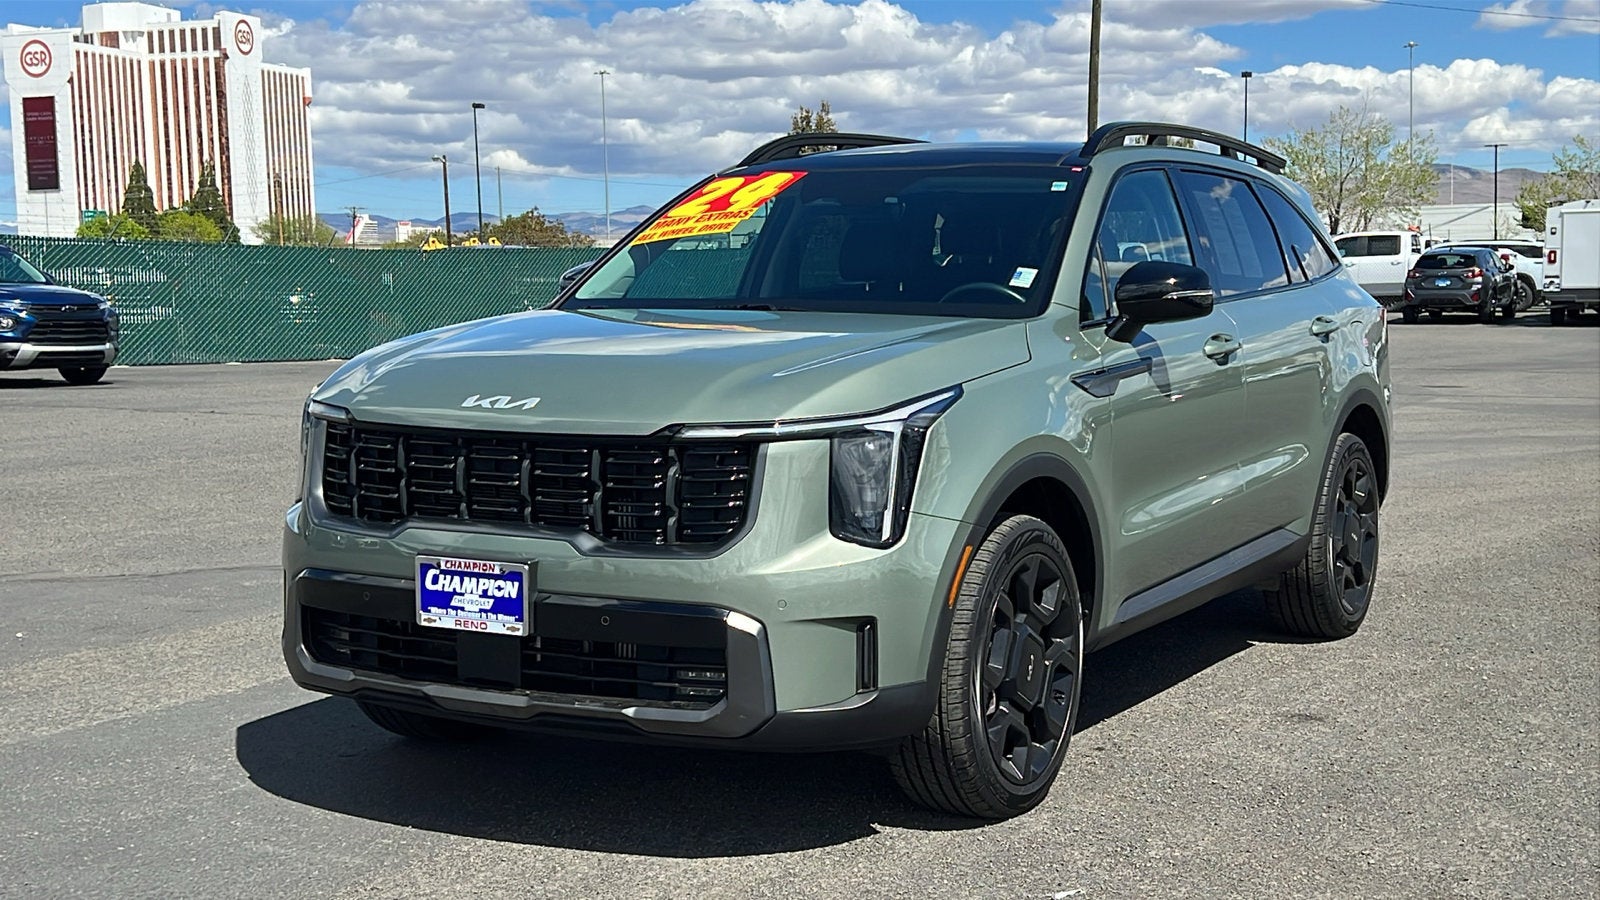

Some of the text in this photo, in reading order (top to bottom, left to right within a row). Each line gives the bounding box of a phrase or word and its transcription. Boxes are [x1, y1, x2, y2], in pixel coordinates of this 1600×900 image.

[237, 29, 251, 45] GSR
[24, 50, 47, 67] GSR
[667, 172, 794, 218] 24
[649, 209, 753, 231] MANY EXTRAS
[637, 221, 737, 241] ALL WHEEL DRIVE
[444, 560, 496, 573] CHAMPION
[425, 568, 519, 598] CHAMPION
[453, 597, 490, 607] CHEVROLET
[454, 619, 488, 630] RENO
